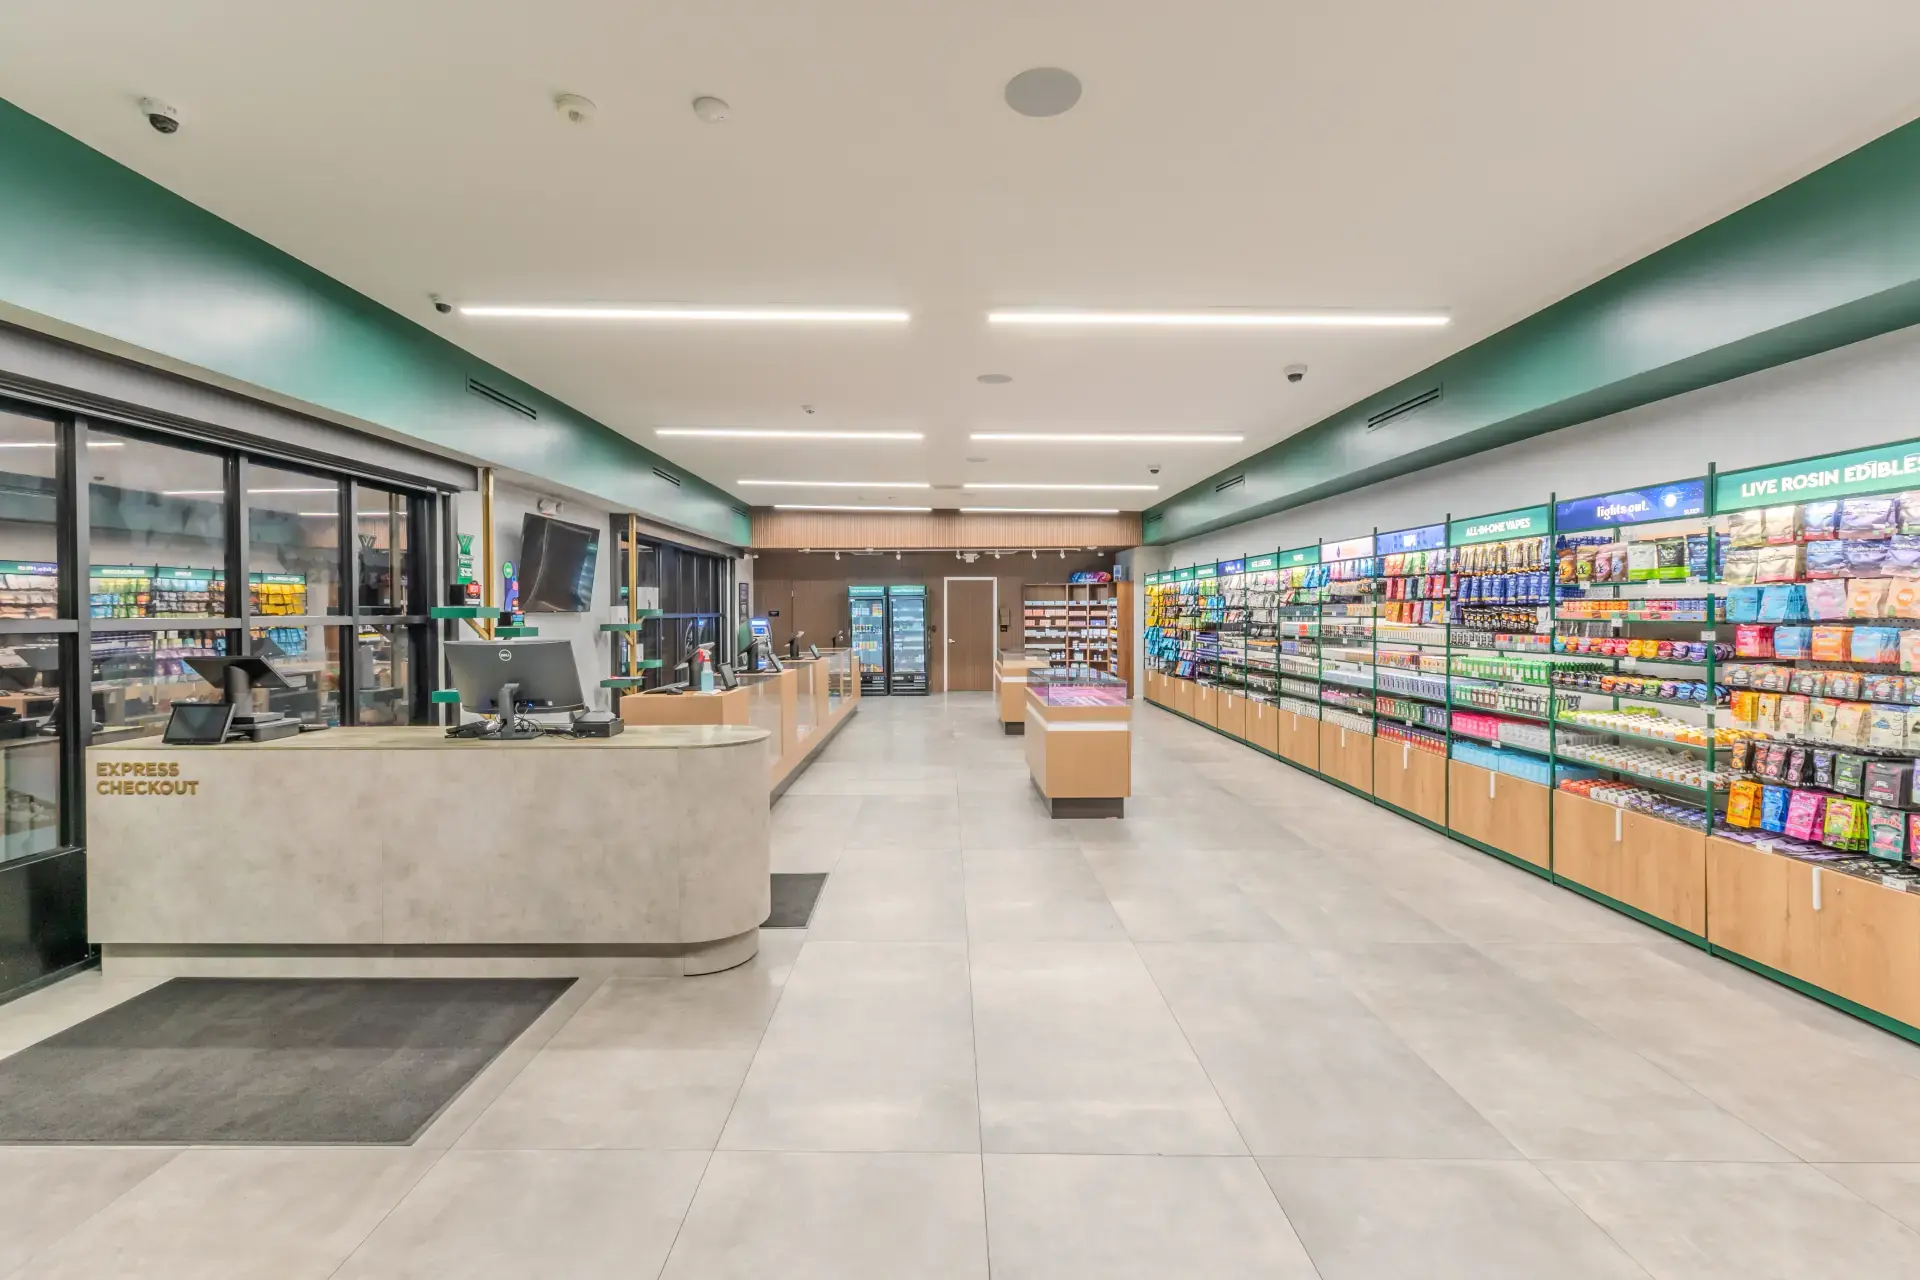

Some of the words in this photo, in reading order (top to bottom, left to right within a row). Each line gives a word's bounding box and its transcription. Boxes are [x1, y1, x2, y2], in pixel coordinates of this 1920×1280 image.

[1741, 479, 1778, 497] LIVE
[1781, 469, 1840, 492] ROSIN
[1596, 505, 1628, 520] lights
[1628, 500, 1650, 513] out.
[1465, 521, 1506, 537] ALL-IN-ONE
[1505, 517, 1531, 531] VAPES
[96, 762, 180, 777] EXPRESS
[96, 780, 199, 796] CHECKOUT
